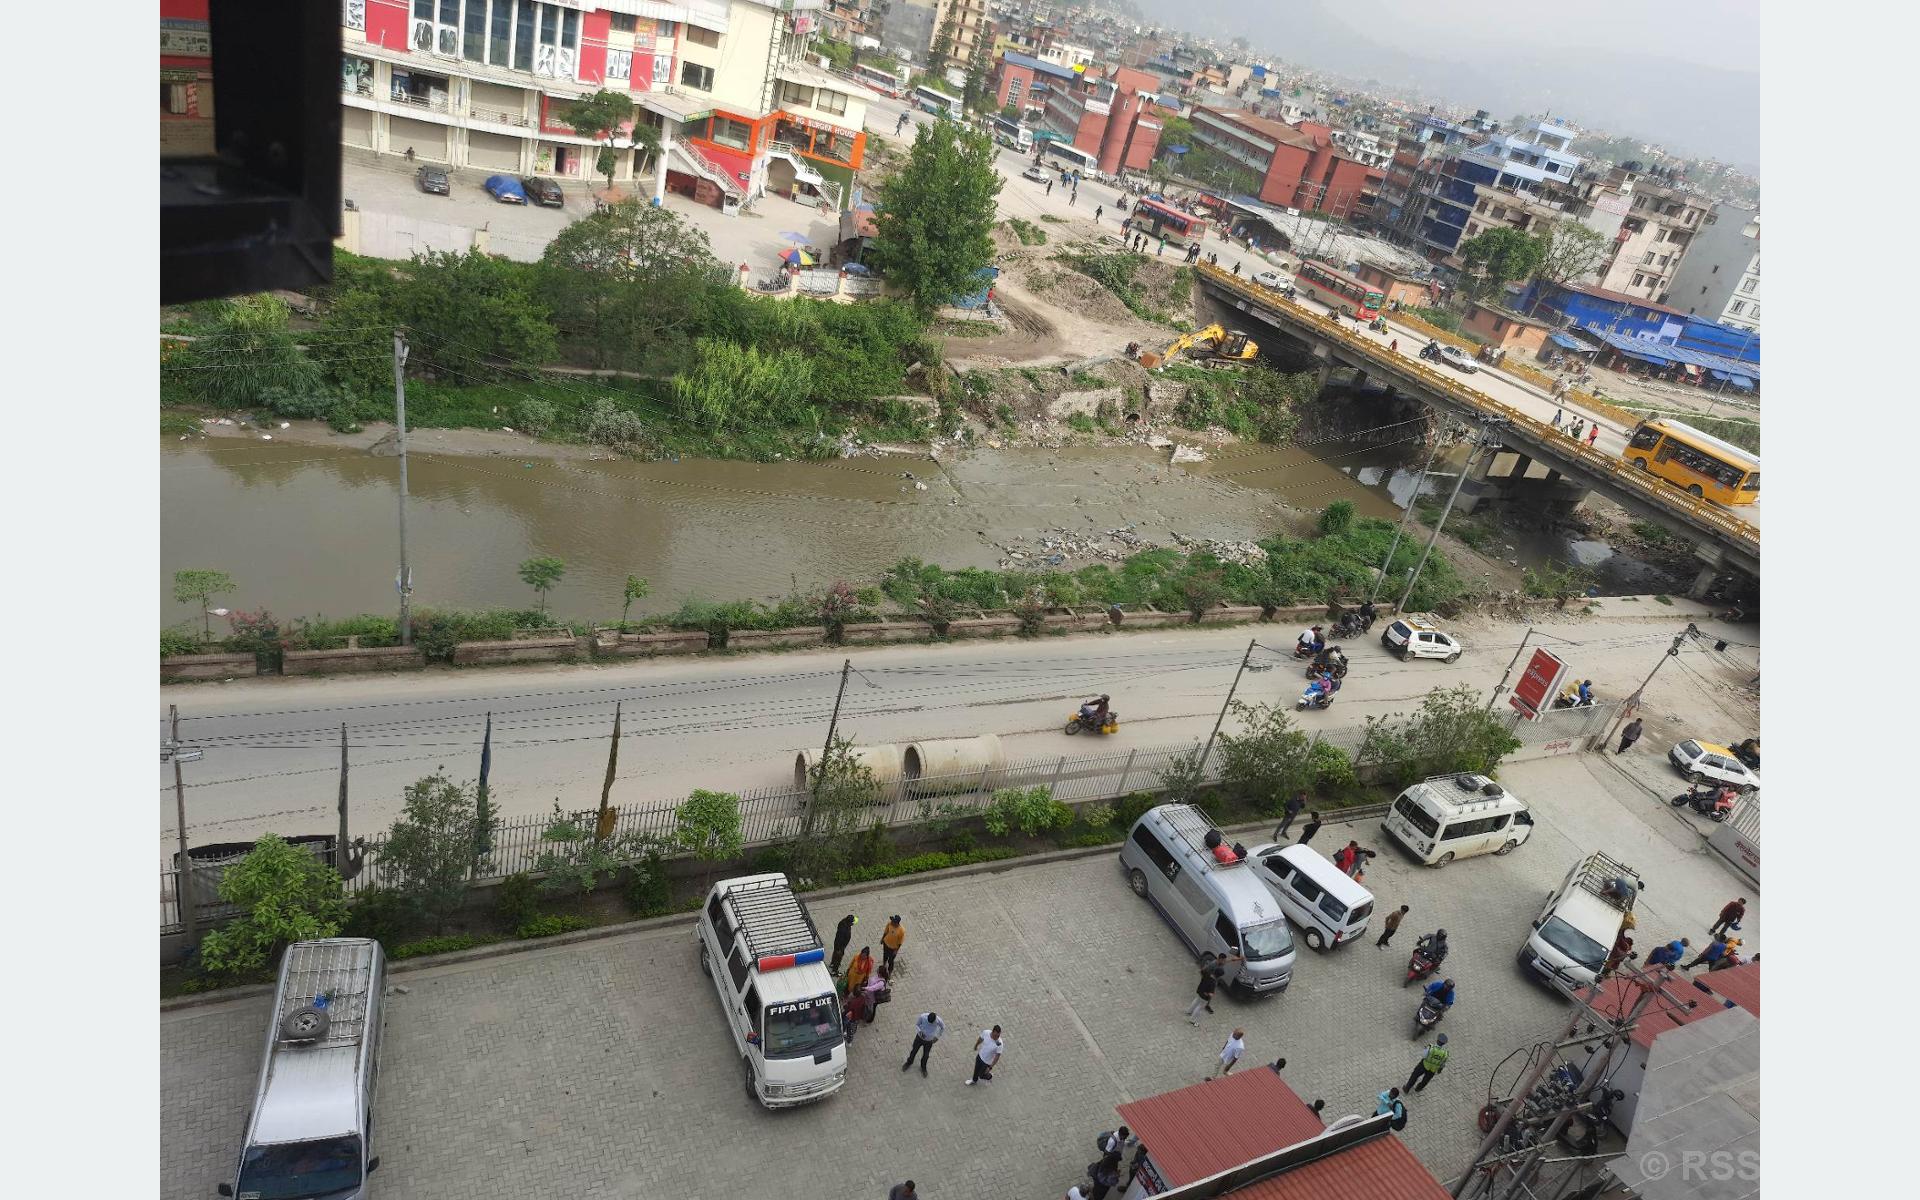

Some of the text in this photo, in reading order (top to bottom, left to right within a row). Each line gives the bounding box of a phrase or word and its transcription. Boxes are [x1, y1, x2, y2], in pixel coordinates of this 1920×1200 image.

[834, 127, 857, 139] HOUSE
[770, 1004, 797, 1016] FIFA
[815, 997, 833, 1007] UXE
